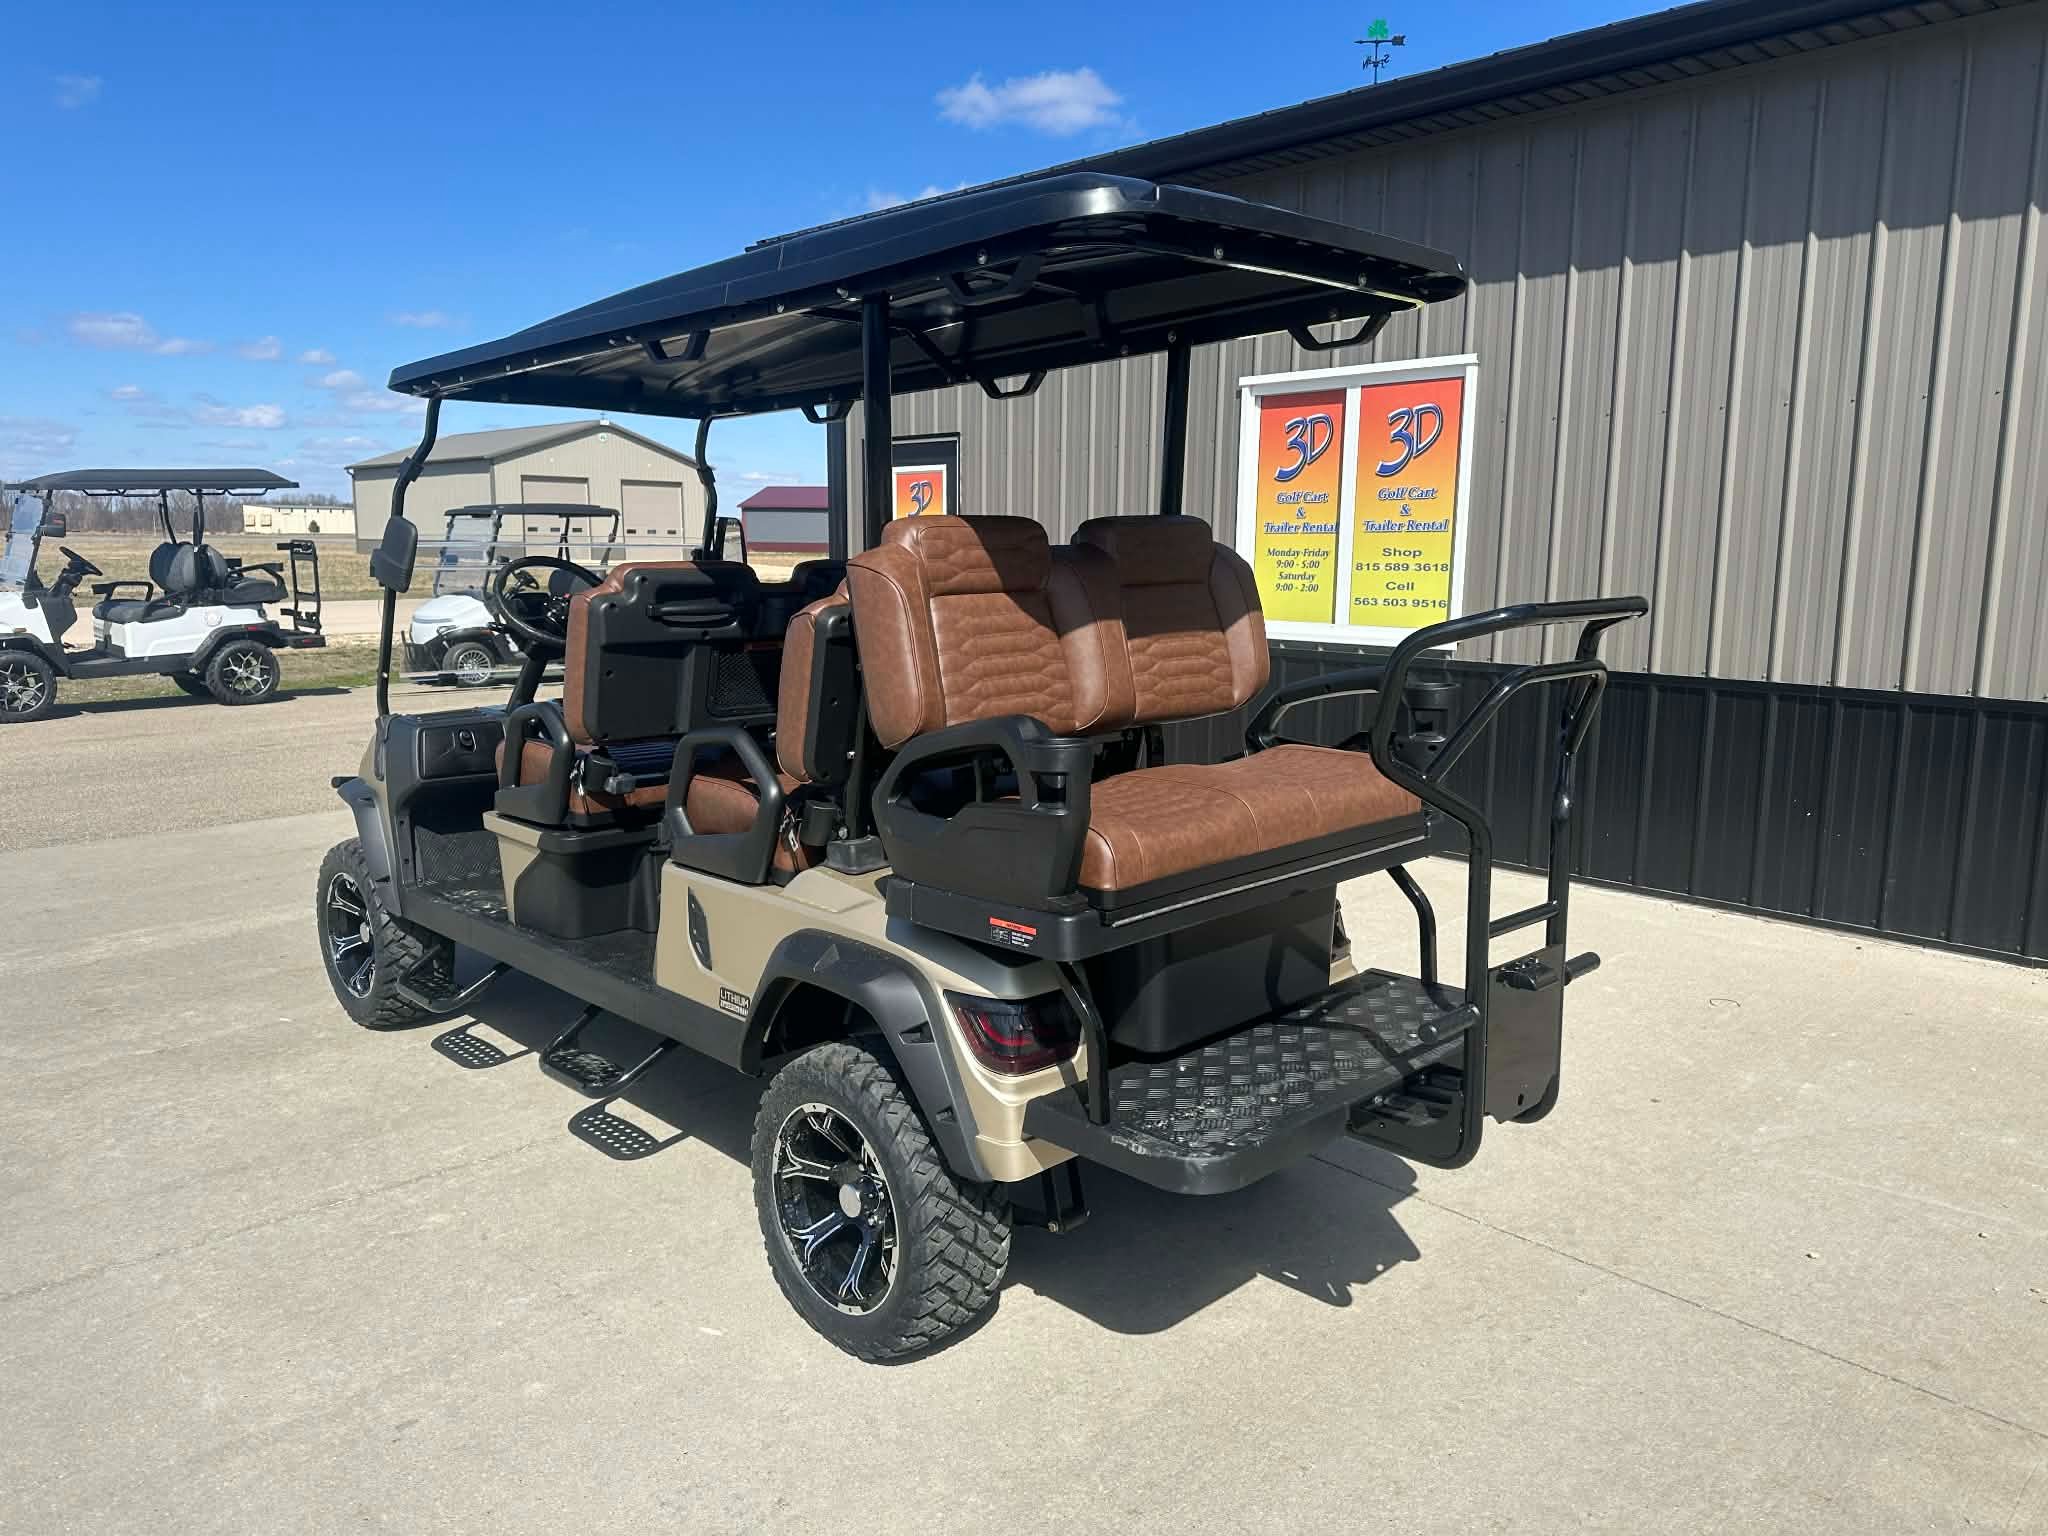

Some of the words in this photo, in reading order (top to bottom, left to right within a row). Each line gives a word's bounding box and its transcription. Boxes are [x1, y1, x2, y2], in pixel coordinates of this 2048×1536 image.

[1375, 403, 1444, 478] 3D
[1274, 413, 1334, 483] 3D
[907, 480, 933, 517] 3D
[1276, 491, 1302, 504] Golf
[1303, 491, 1329, 504] Cart
[1377, 487, 1407, 500] Golf
[1407, 487, 1438, 500] Cart
[1296, 507, 1306, 519] &
[1400, 504, 1411, 516] &
[1264, 521, 1300, 534] Trailer
[1301, 521, 1339, 534] Rental
[1362, 519, 1404, 533] Trailer
[1405, 519, 1449, 533] Rental
[1382, 548, 1422, 559] Shop
[1276, 560, 1294, 568] 9:00
[1301, 560, 1320, 569] 5:00
[1355, 562, 1380, 571] 815
[1384, 562, 1409, 571] 589
[1414, 563, 1449, 572] 3618
[1278, 571, 1316, 583] Saturday
[1275, 583, 1293, 592] 9:00
[1300, 583, 1319, 592] 2:00
[1385, 581, 1415, 591] Cell
[1354, 597, 1378, 606] 563
[1383, 598, 1407, 607] 503
[1412, 599, 1447, 608] 9516
[720, 988, 749, 1008] LITHIUM
